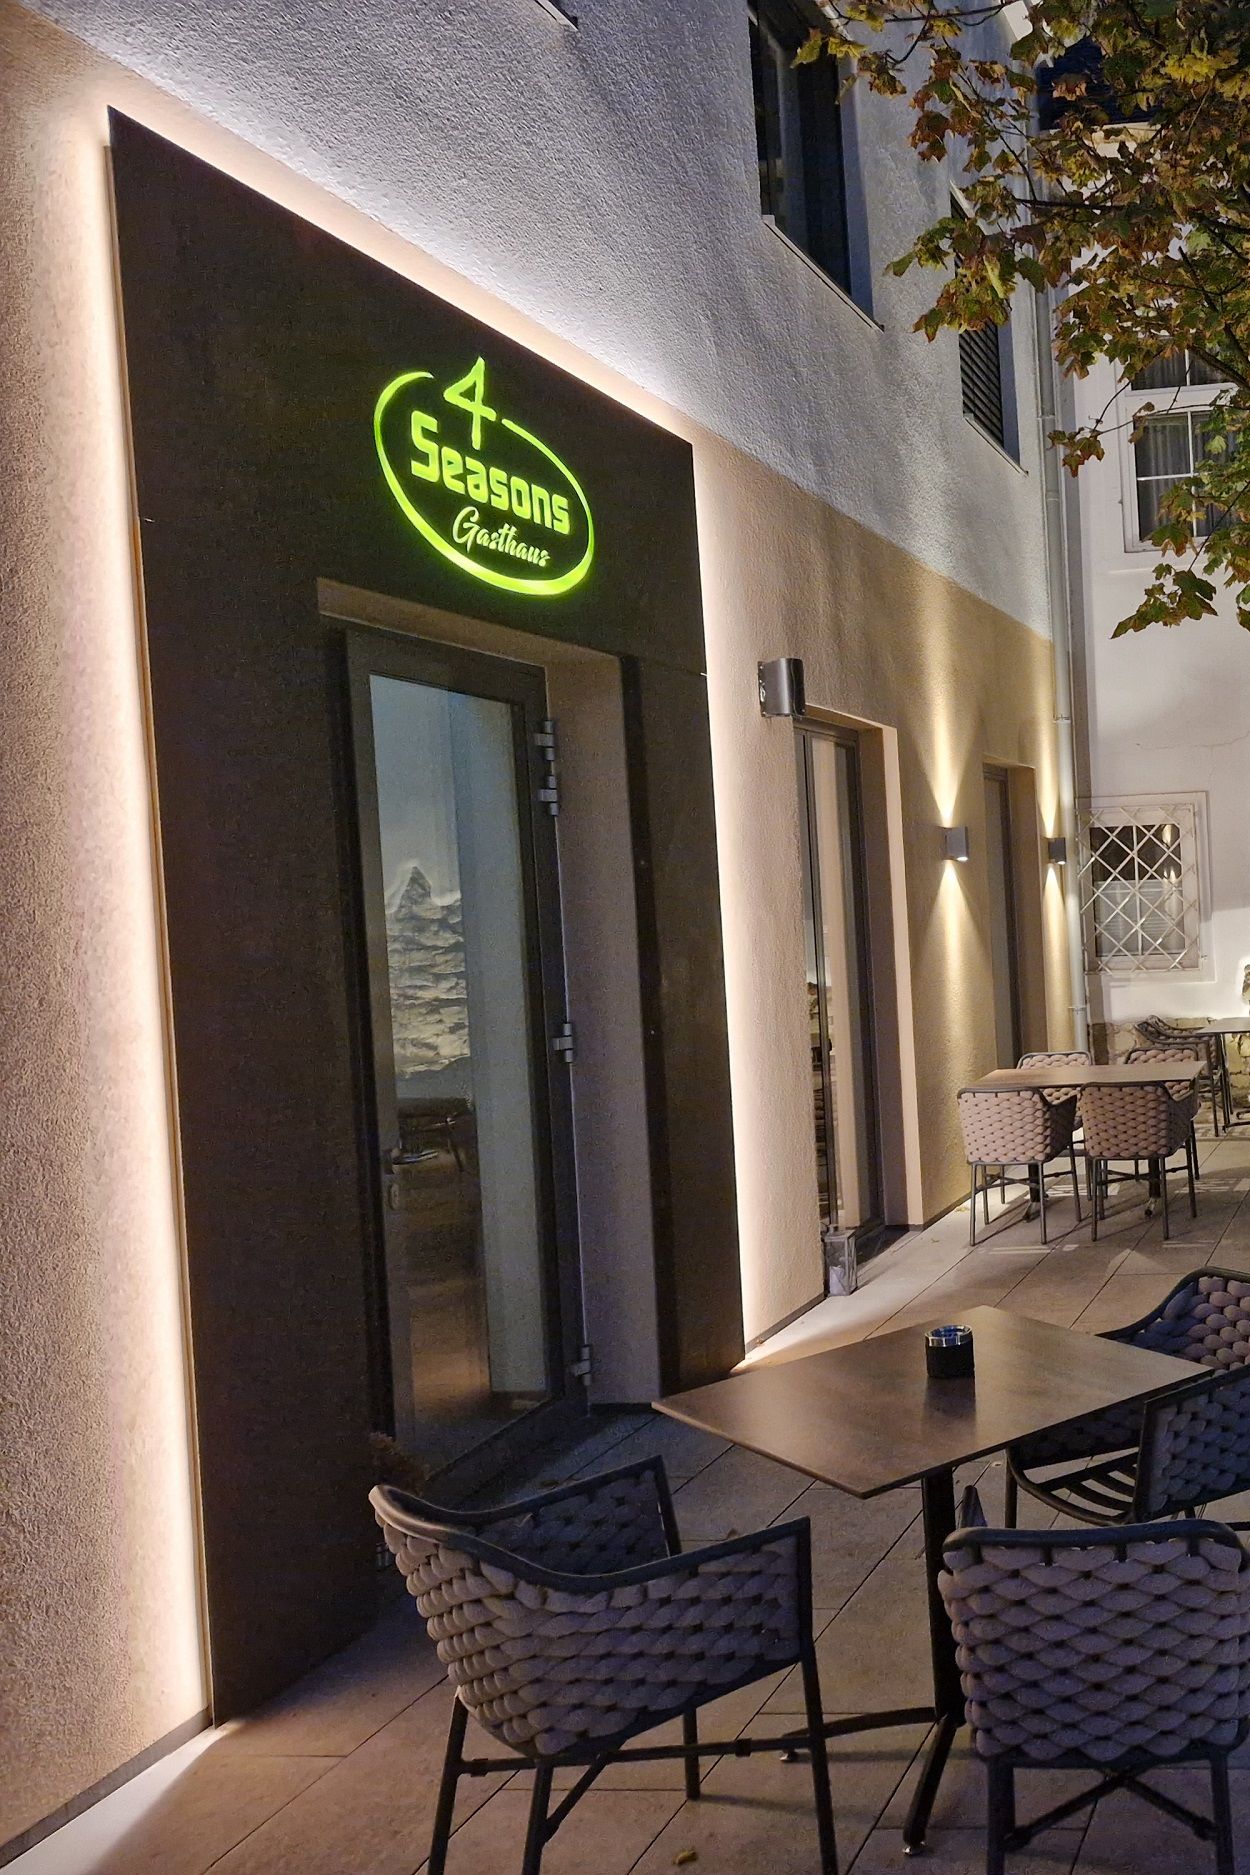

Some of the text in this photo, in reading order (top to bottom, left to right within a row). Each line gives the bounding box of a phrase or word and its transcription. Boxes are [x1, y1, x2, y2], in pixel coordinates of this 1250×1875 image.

[443, 356, 497, 450] 4
[410, 409, 571, 535] Seasons
[452, 506, 551, 567] Gasthaus
